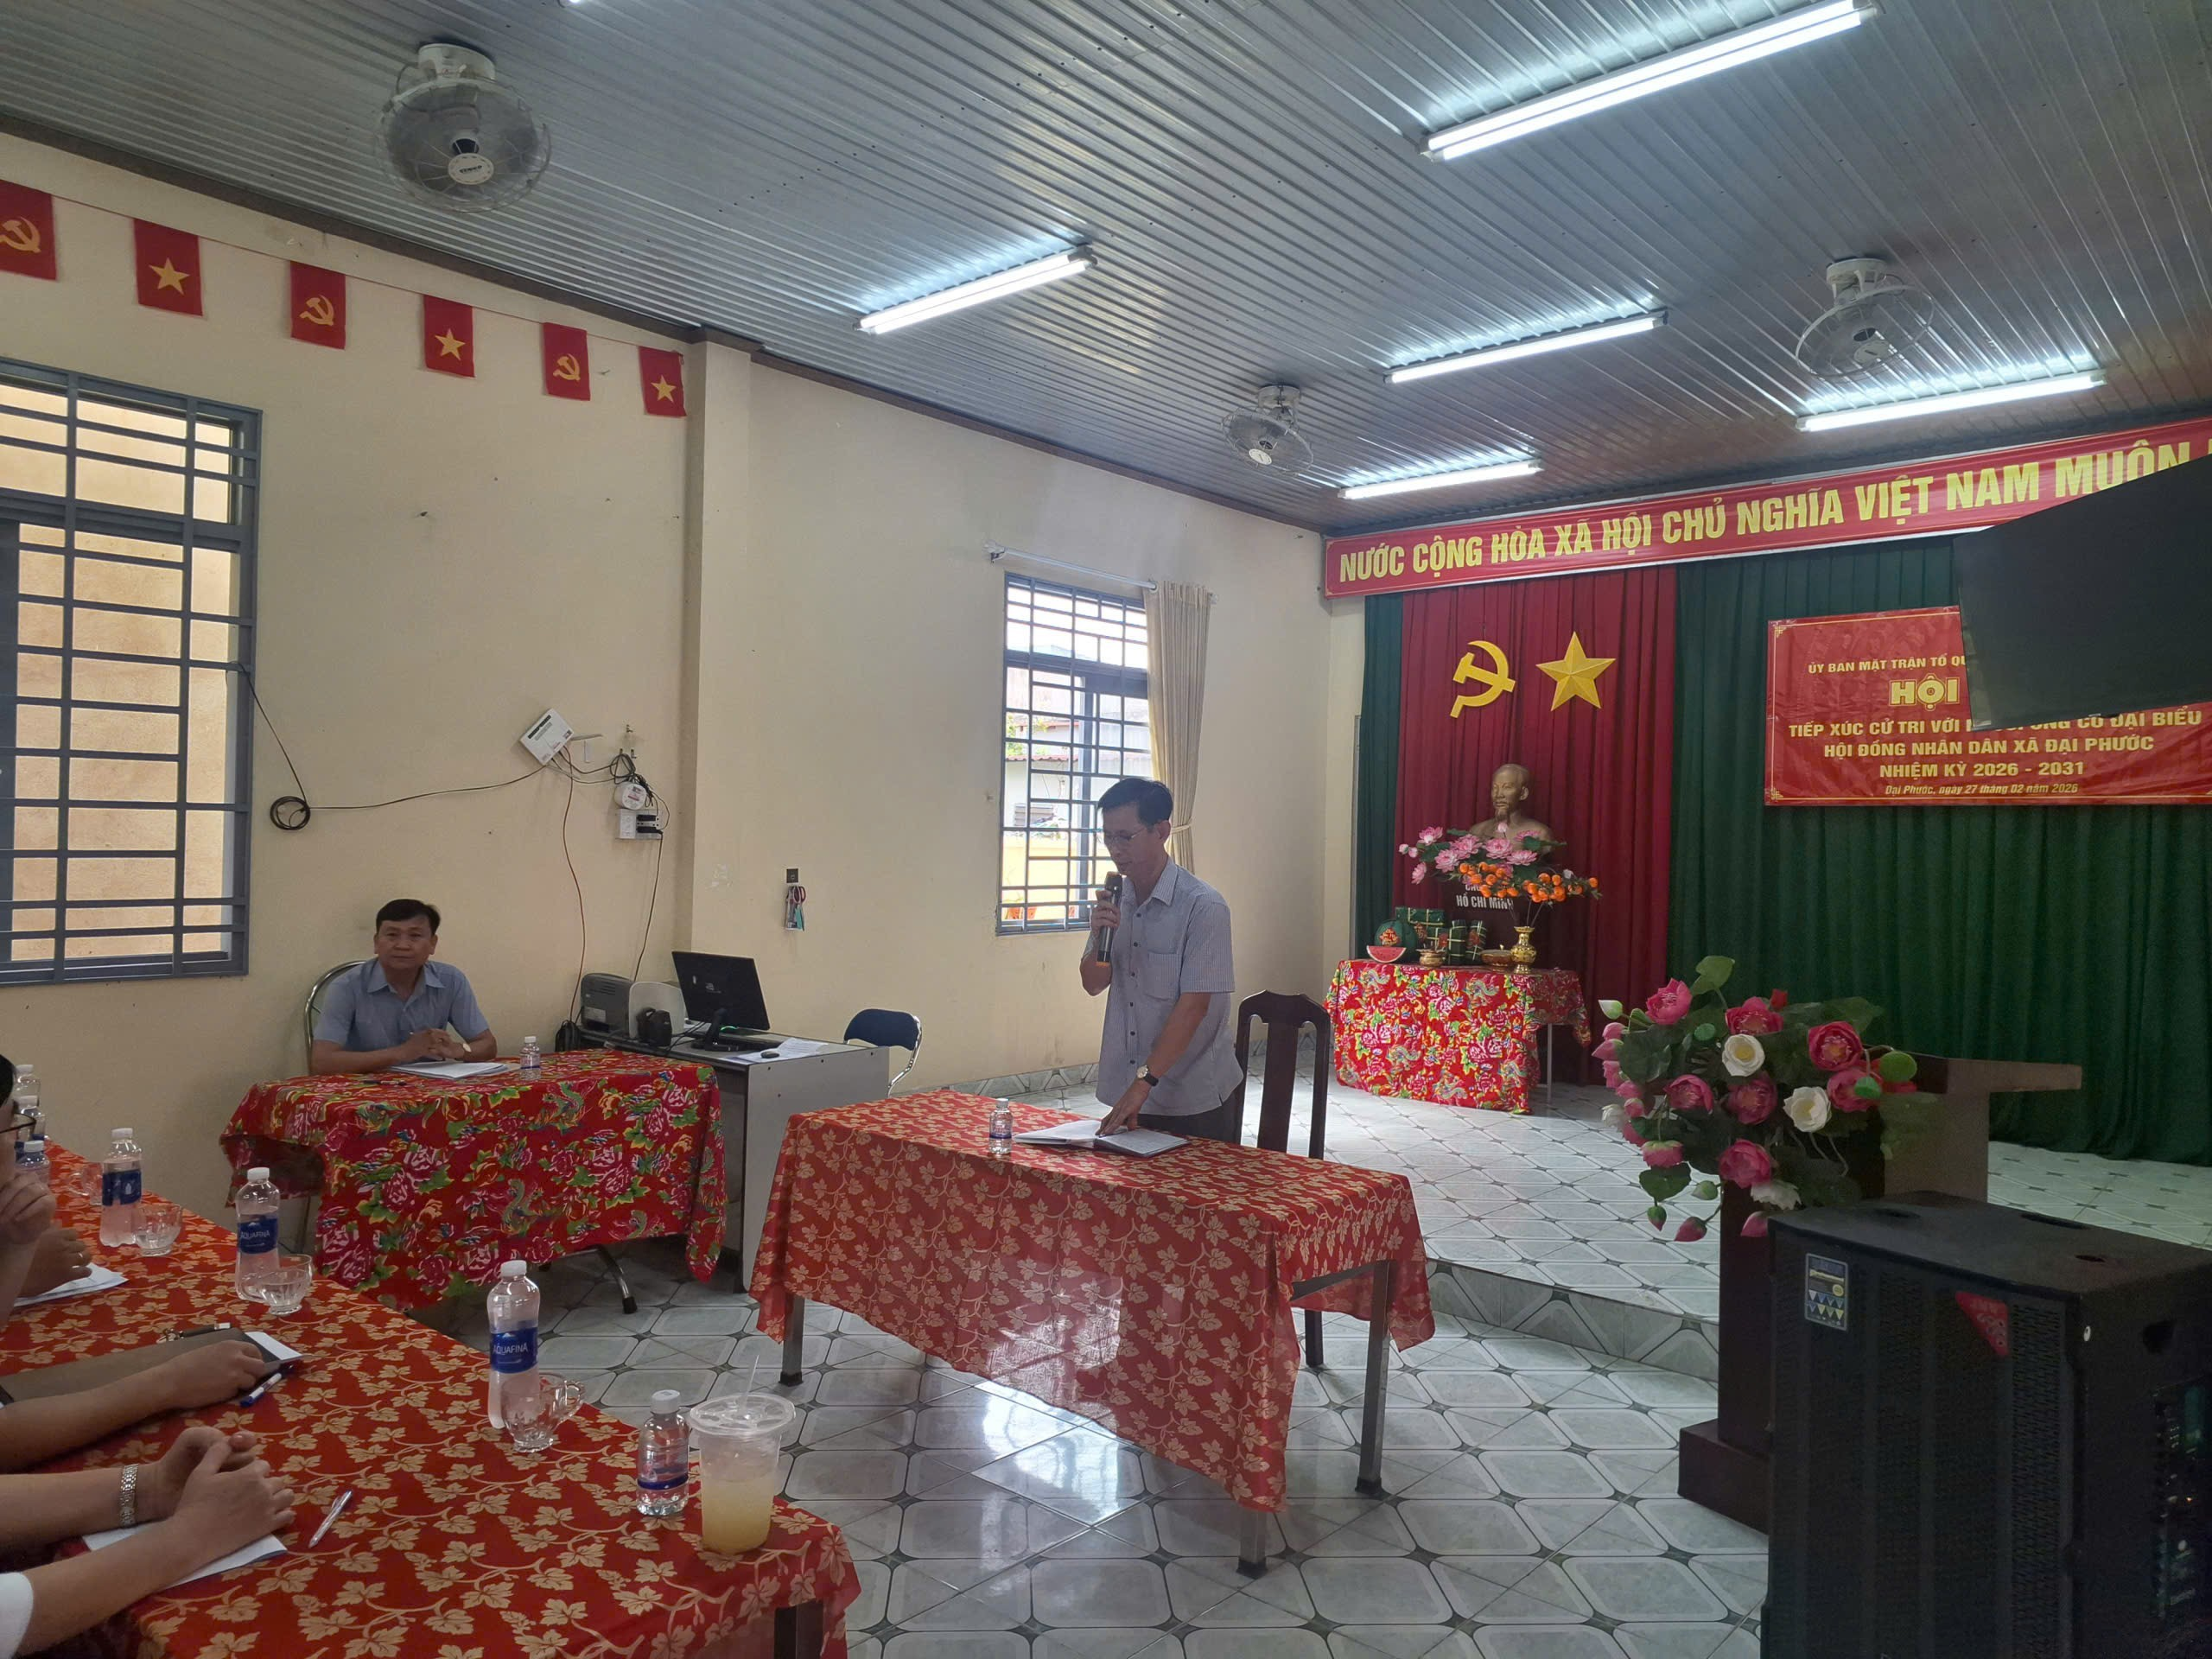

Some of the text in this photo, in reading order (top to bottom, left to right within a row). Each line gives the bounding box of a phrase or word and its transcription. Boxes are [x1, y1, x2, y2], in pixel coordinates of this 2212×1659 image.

[1339, 544, 1405, 582] NƯỚC
[1413, 535, 1484, 578] CỘNG
[1491, 524, 1547, 563] HÒA
[1554, 518, 1594, 556] XÃ
[1603, 511, 1652, 556] HỘI
[1662, 497, 1726, 543] CHỦ
[1737, 487, 1844, 536] NGHĨA
[1854, 475, 1934, 525] VIỆT
[1946, 461, 2040, 512] NAM
[1808, 661, 1824, 674] ỦY
[1828, 663, 1854, 672] BAN
[1859, 658, 1887, 672] MẶT
[1891, 657, 1926, 670] TRẬN
[1930, 653, 1947, 666] TỔ
[1889, 673, 1960, 711] HỘI
[1789, 721, 1824, 737] TIẾP
[1830, 721, 1863, 735] XÚC
[1870, 718, 1895, 734] CỬ
[1897, 721, 1924, 734] TRI
[1931, 717, 1959, 733] VỚI
[2152, 706, 2202, 726] BIỂU
[1825, 742, 1852, 760] HỘI
[1912, 740, 1961, 755] NHÂN
[1968, 739, 2006, 753] DÂN
[2013, 737, 2038, 753] XÃ
[2045, 739, 2077, 754] ĐẠI
[2085, 734, 2154, 751] PHƯỚC
[1880, 762, 1937, 779] NHIỆM
[1944, 761, 1967, 776] KỲ
[1974, 763, 2018, 776] 2026
[2038, 762, 2083, 775] 2031
[1964, 785, 1978, 794] 27
[2051, 783, 2078, 793] 2026
[1456, 892, 1469, 907] HỒ
[493, 1342, 529, 1356] AQUAFINA
